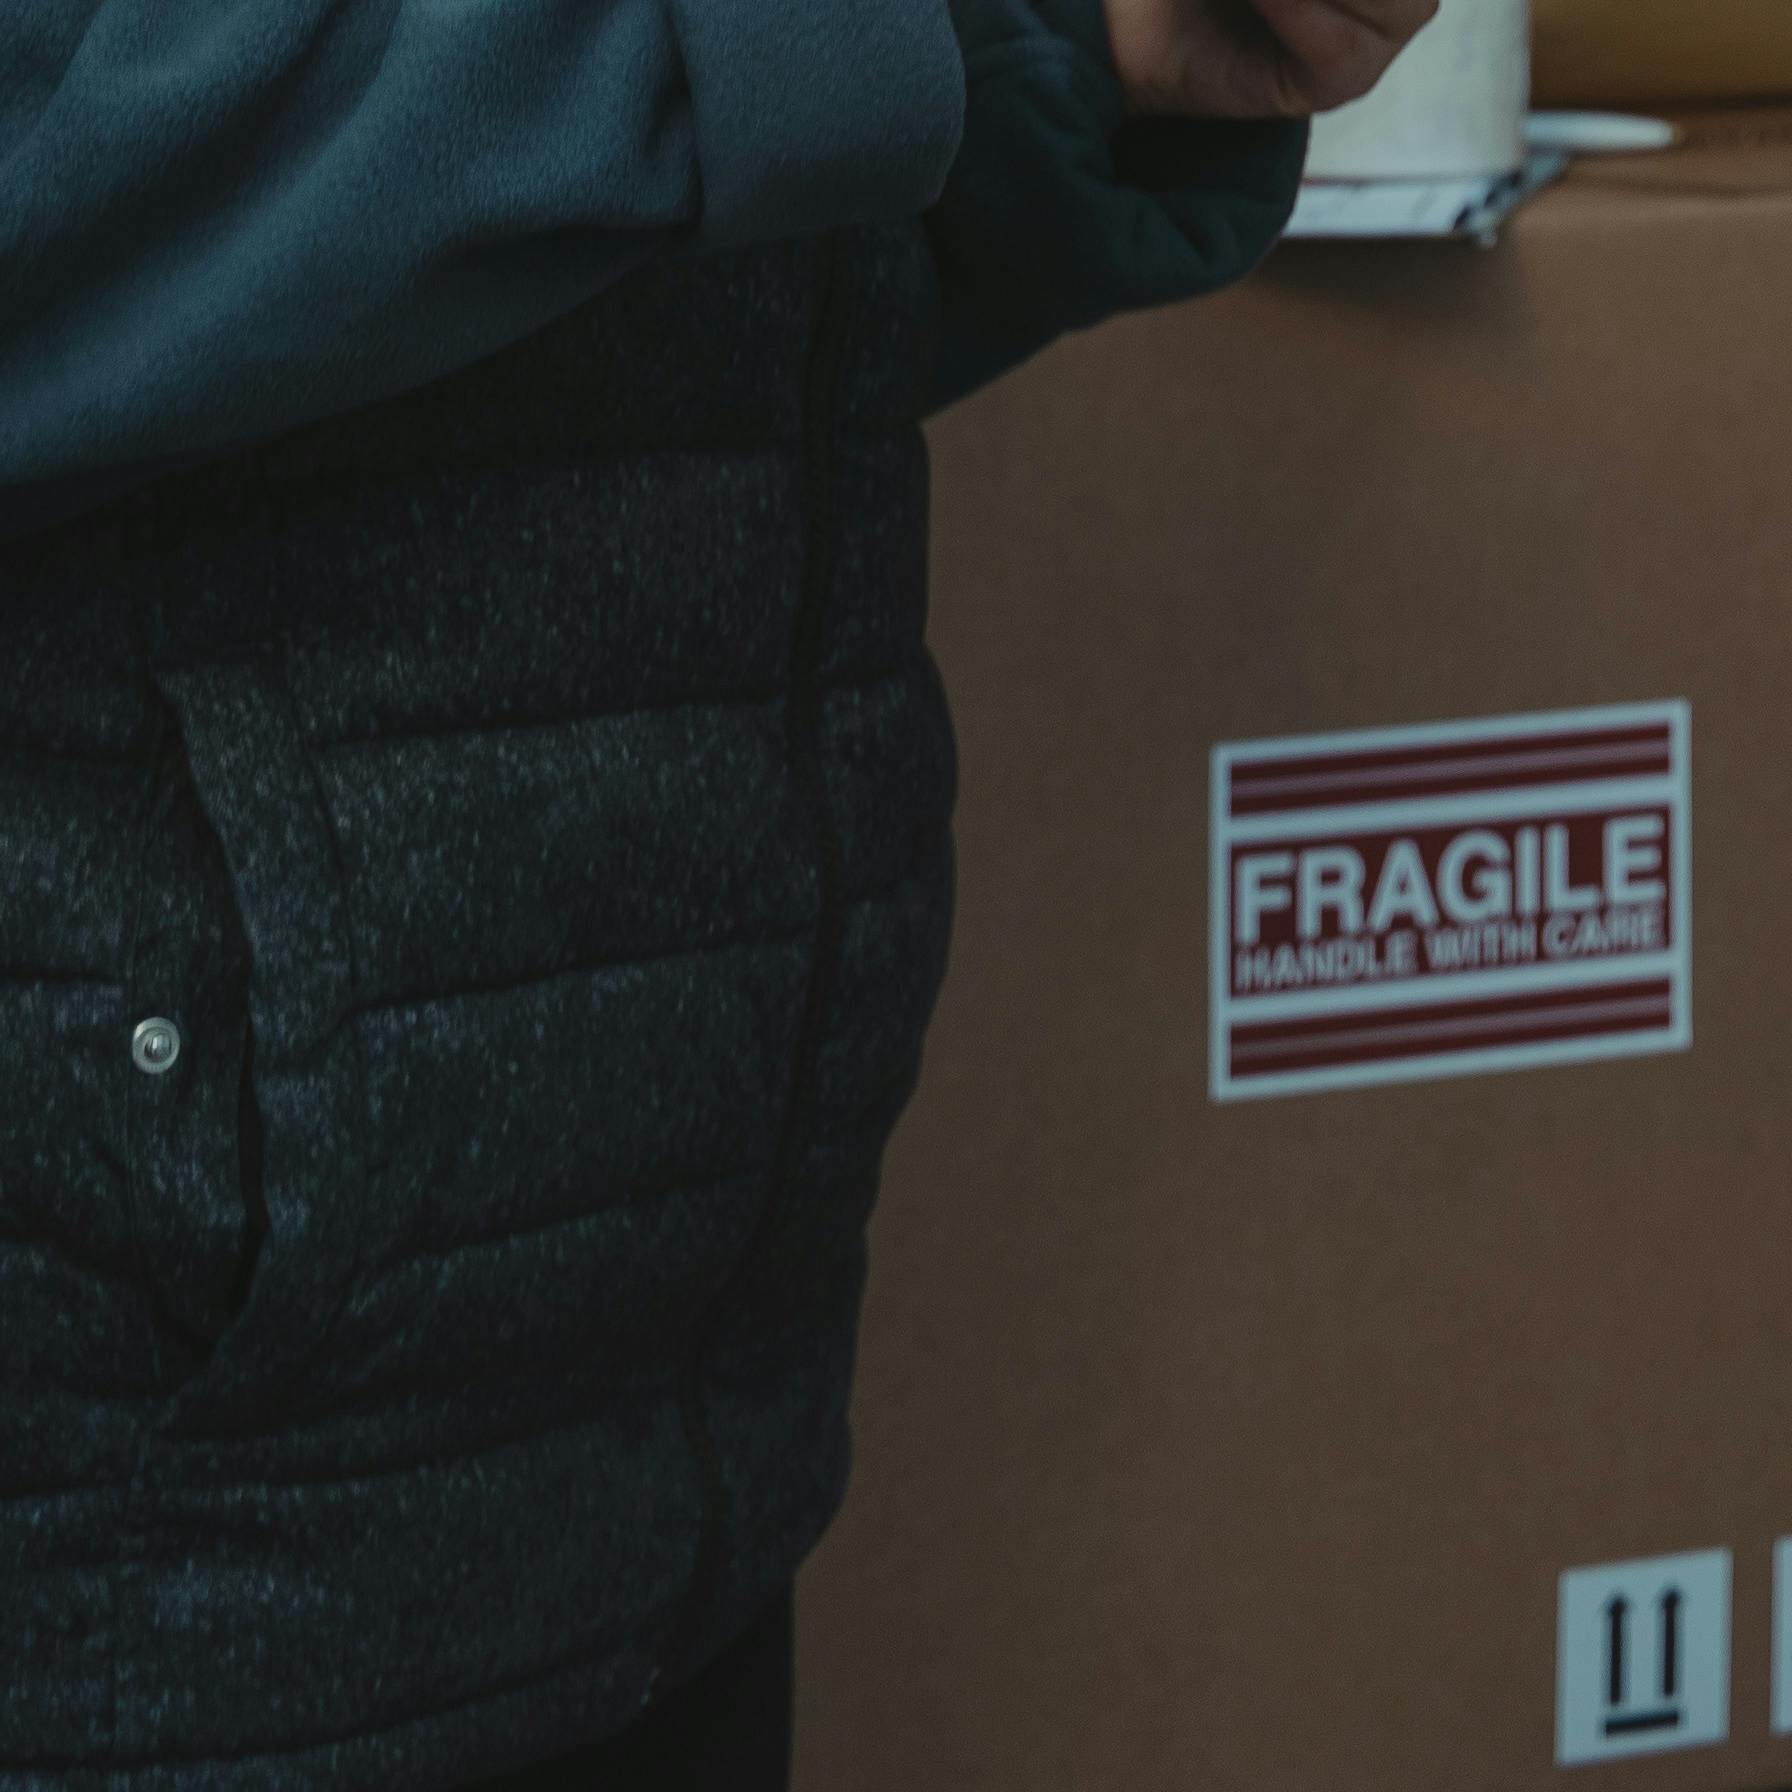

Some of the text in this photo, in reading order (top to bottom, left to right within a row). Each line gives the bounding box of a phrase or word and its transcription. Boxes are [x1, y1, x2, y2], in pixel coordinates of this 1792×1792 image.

[1236, 816, 1665, 944] FRAGILE
[1236, 903, 1661, 992] HANDLE WITH CARE
